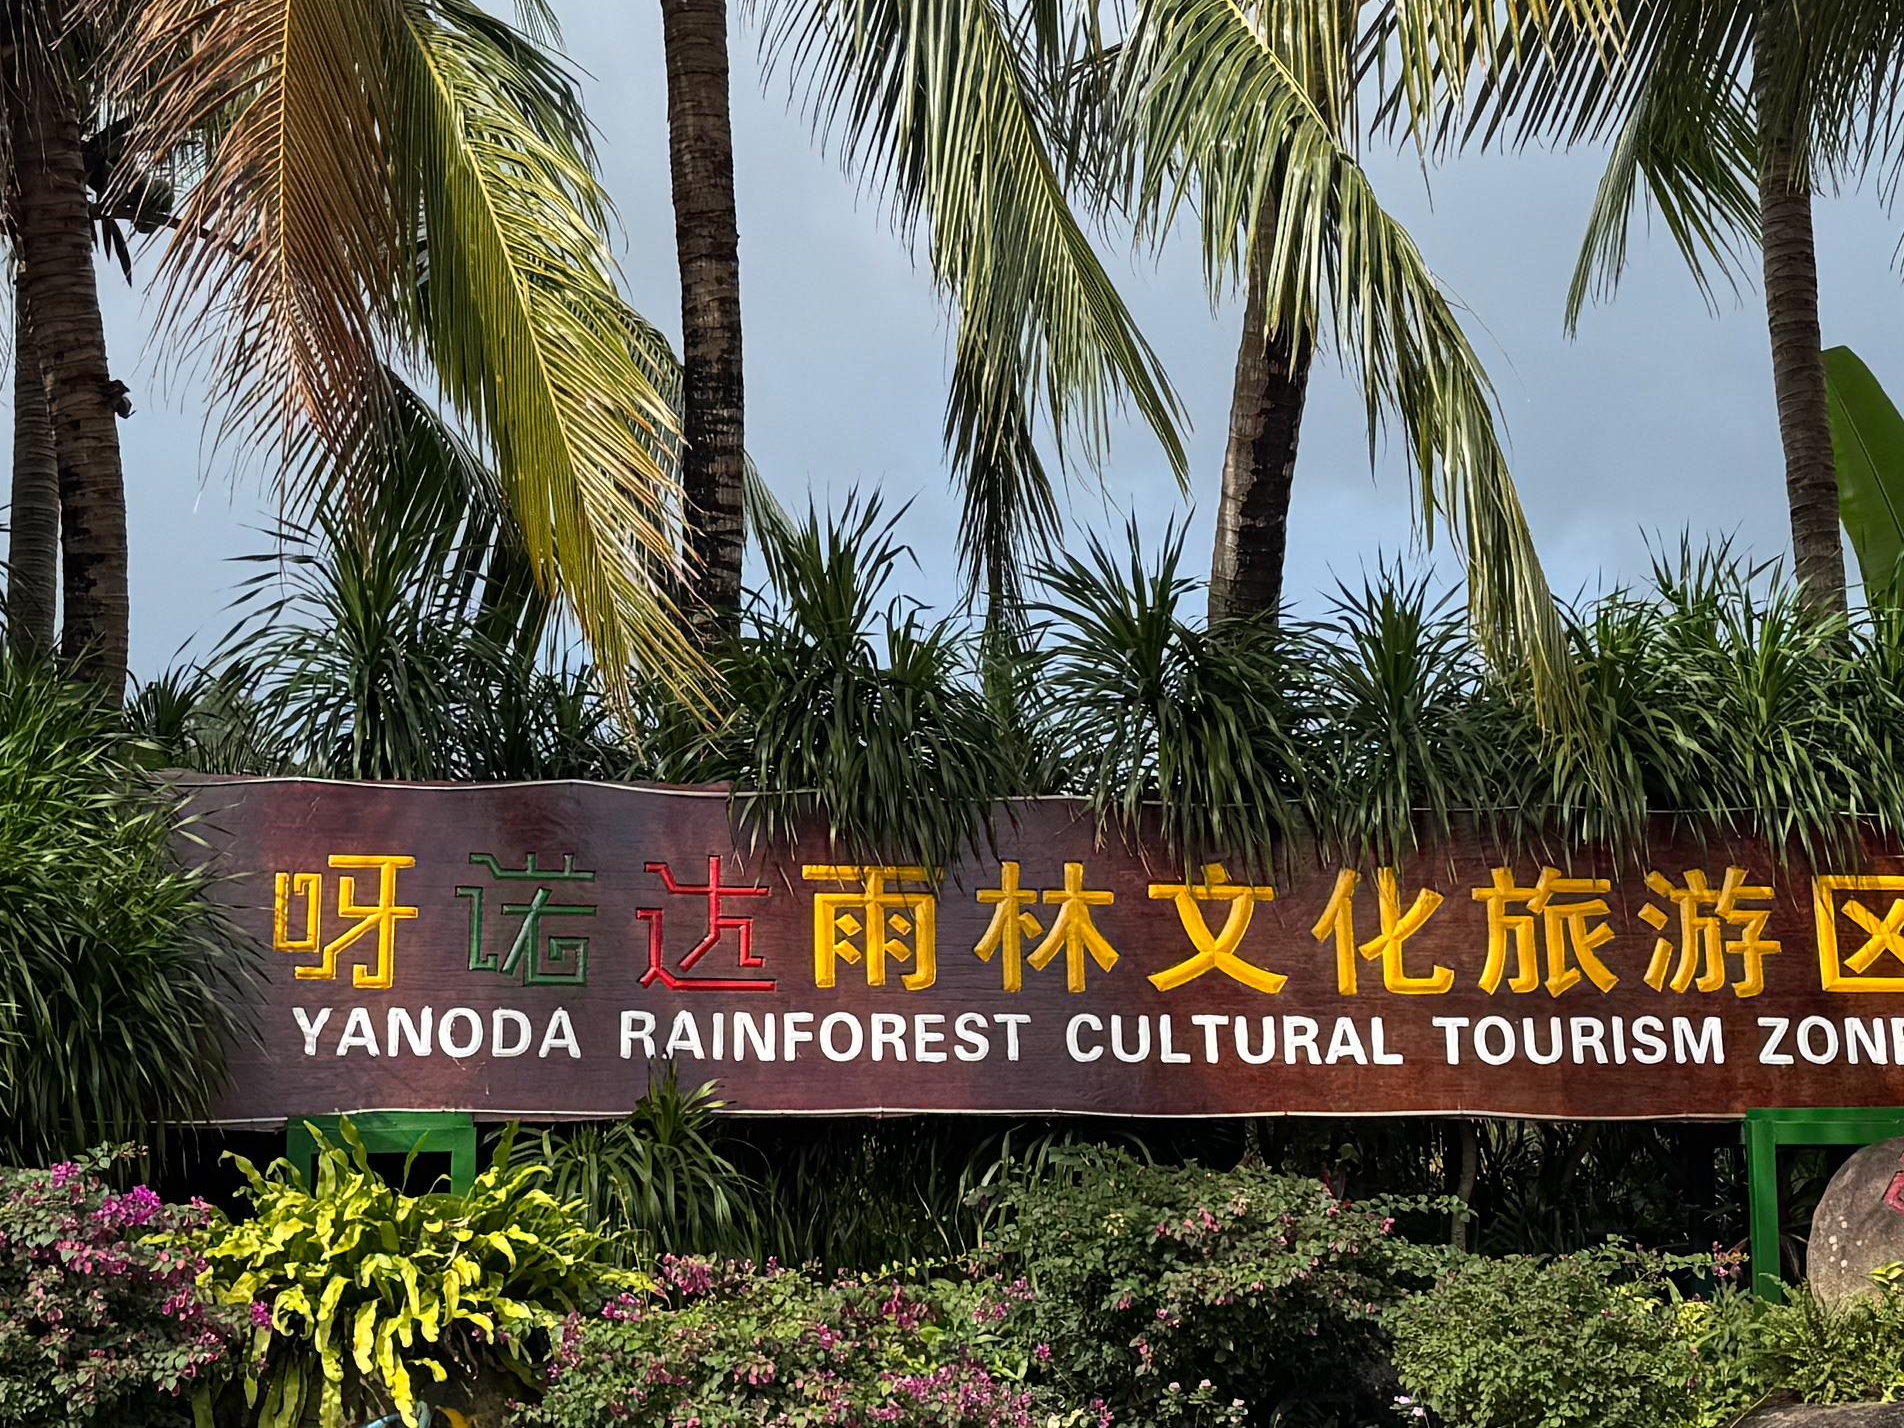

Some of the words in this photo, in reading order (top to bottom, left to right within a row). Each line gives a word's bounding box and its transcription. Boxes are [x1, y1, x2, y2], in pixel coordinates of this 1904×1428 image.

[291, 1006, 582, 1060] YANODA
[618, 1008, 1032, 1063] RAINFOREST
[1065, 1012, 1405, 1066] CULTURAL
[1431, 1015, 1724, 1066] TOURISM
